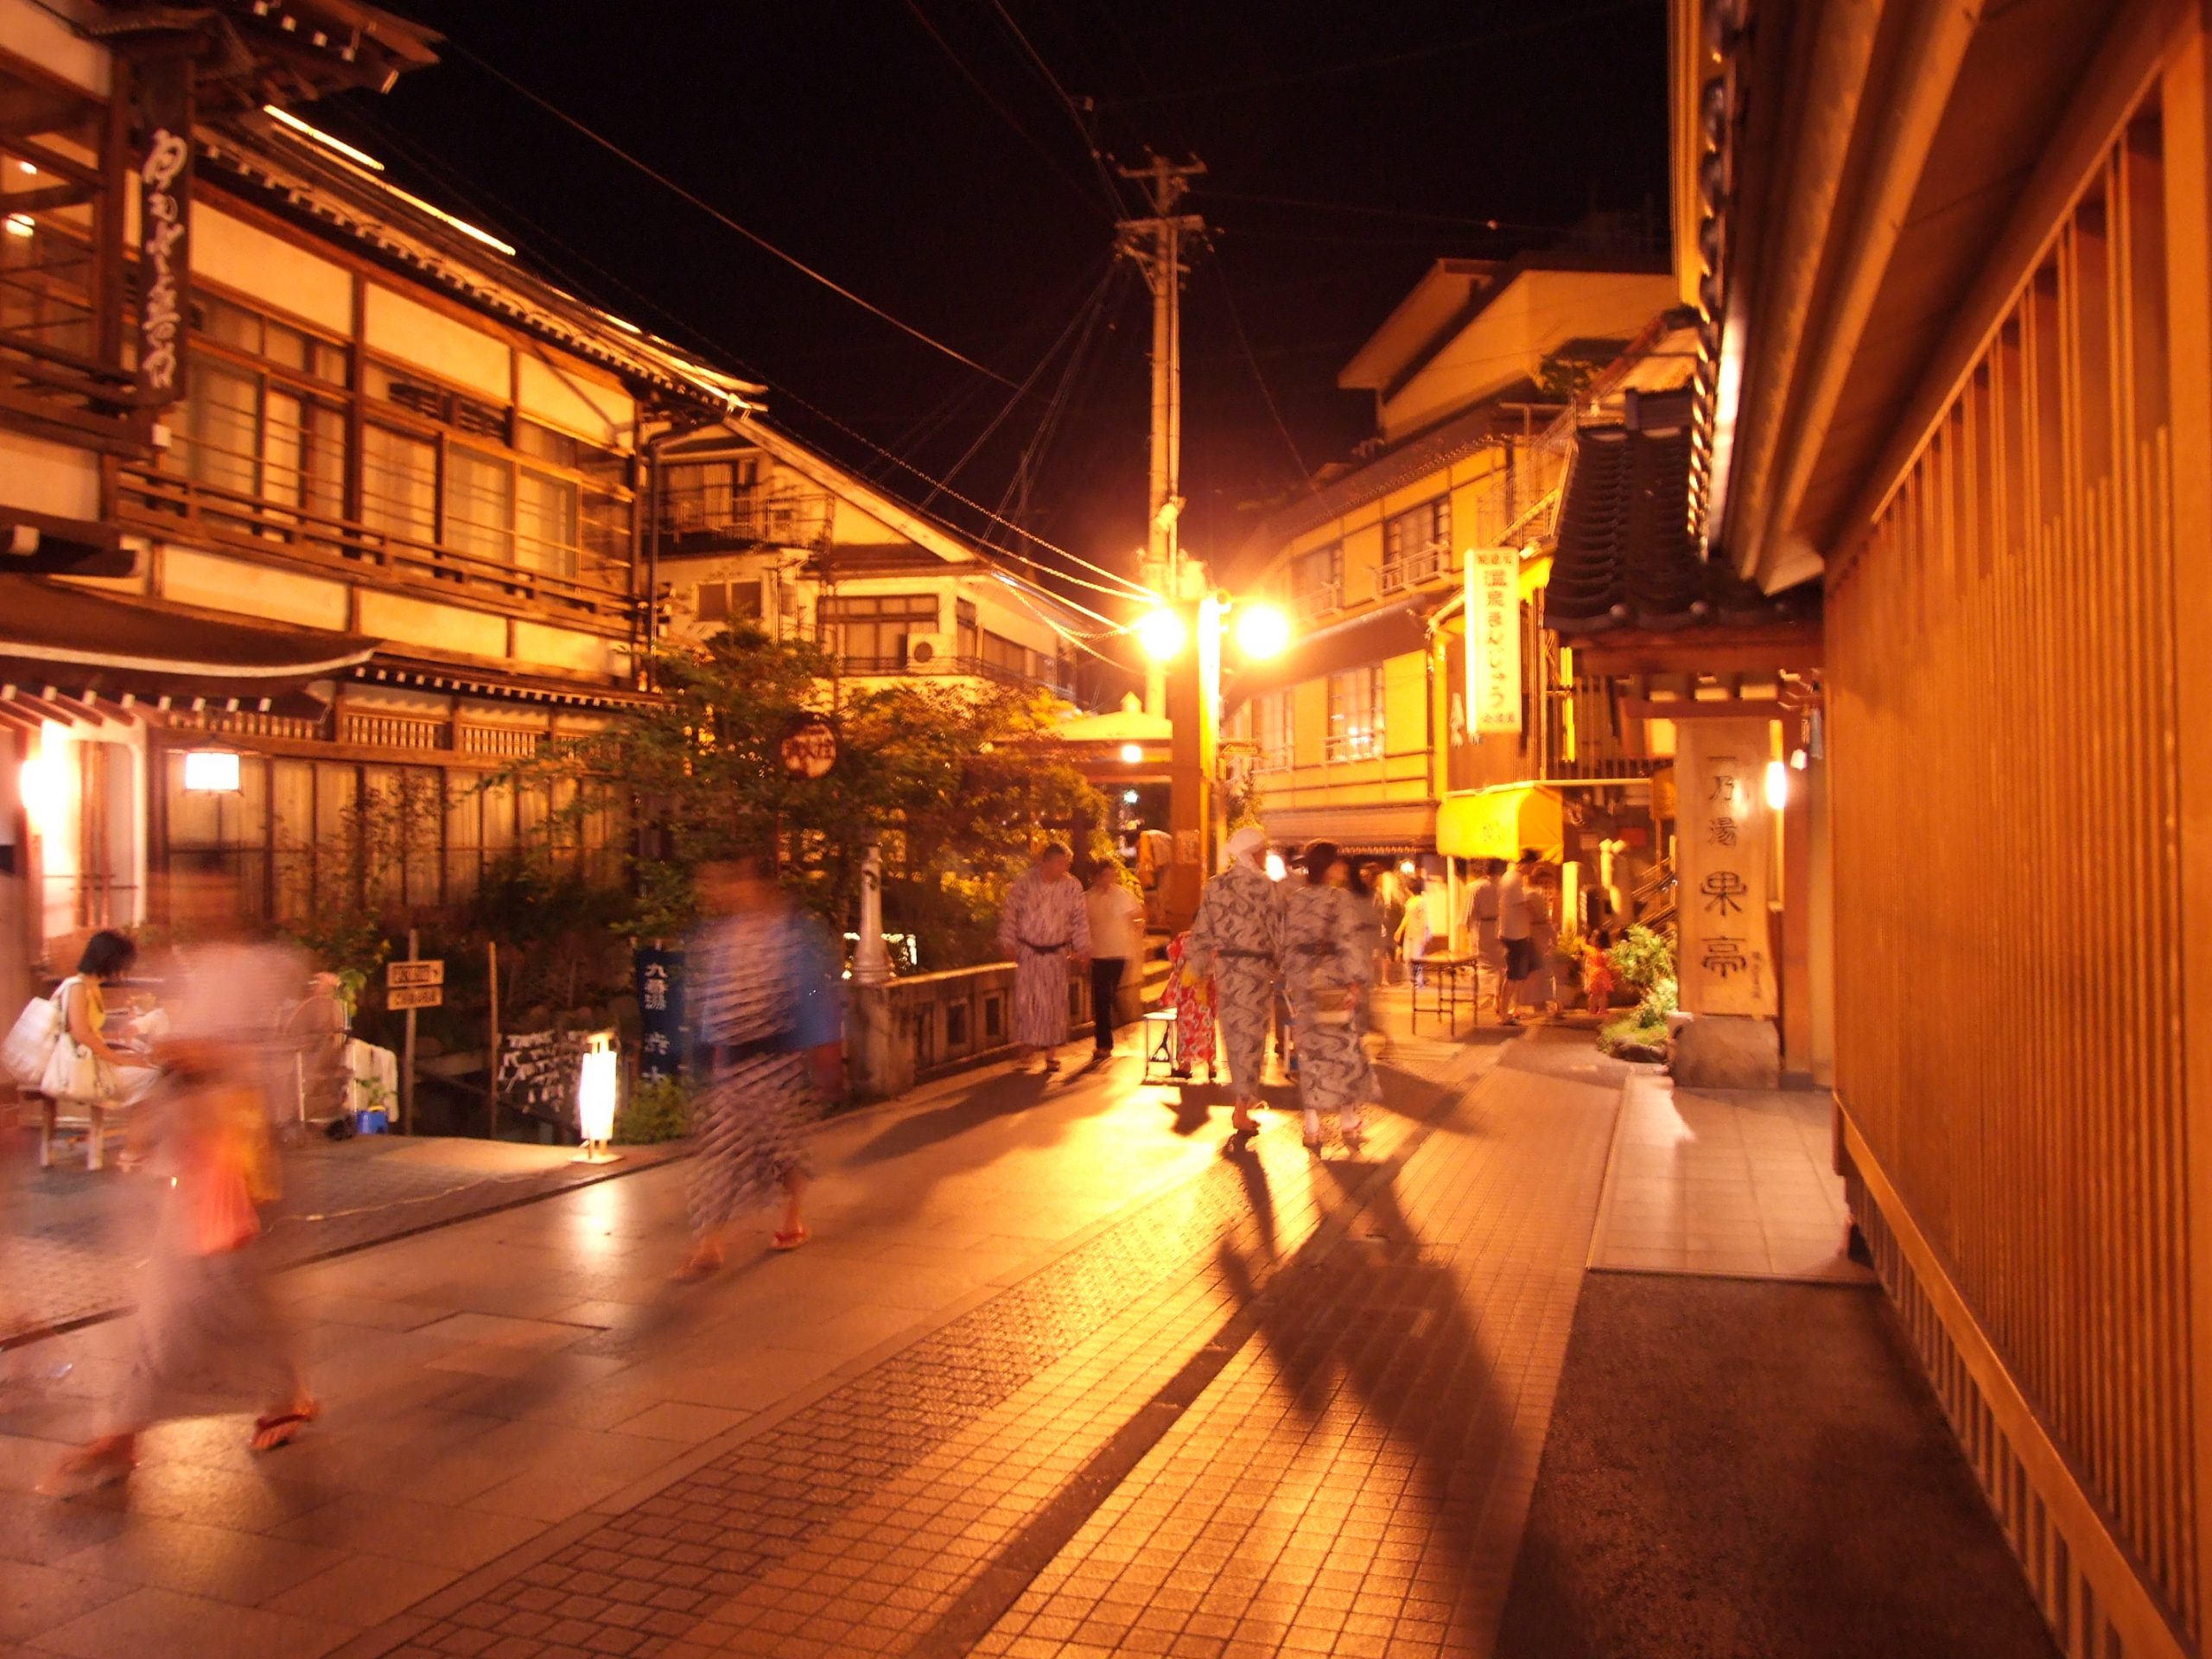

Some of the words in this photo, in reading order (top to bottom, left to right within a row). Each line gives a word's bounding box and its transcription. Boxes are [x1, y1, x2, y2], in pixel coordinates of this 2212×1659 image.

[1484, 569, 1507, 707] 温泉まんじゅう
[1700, 755, 1748, 978] 一乃湯果亭
